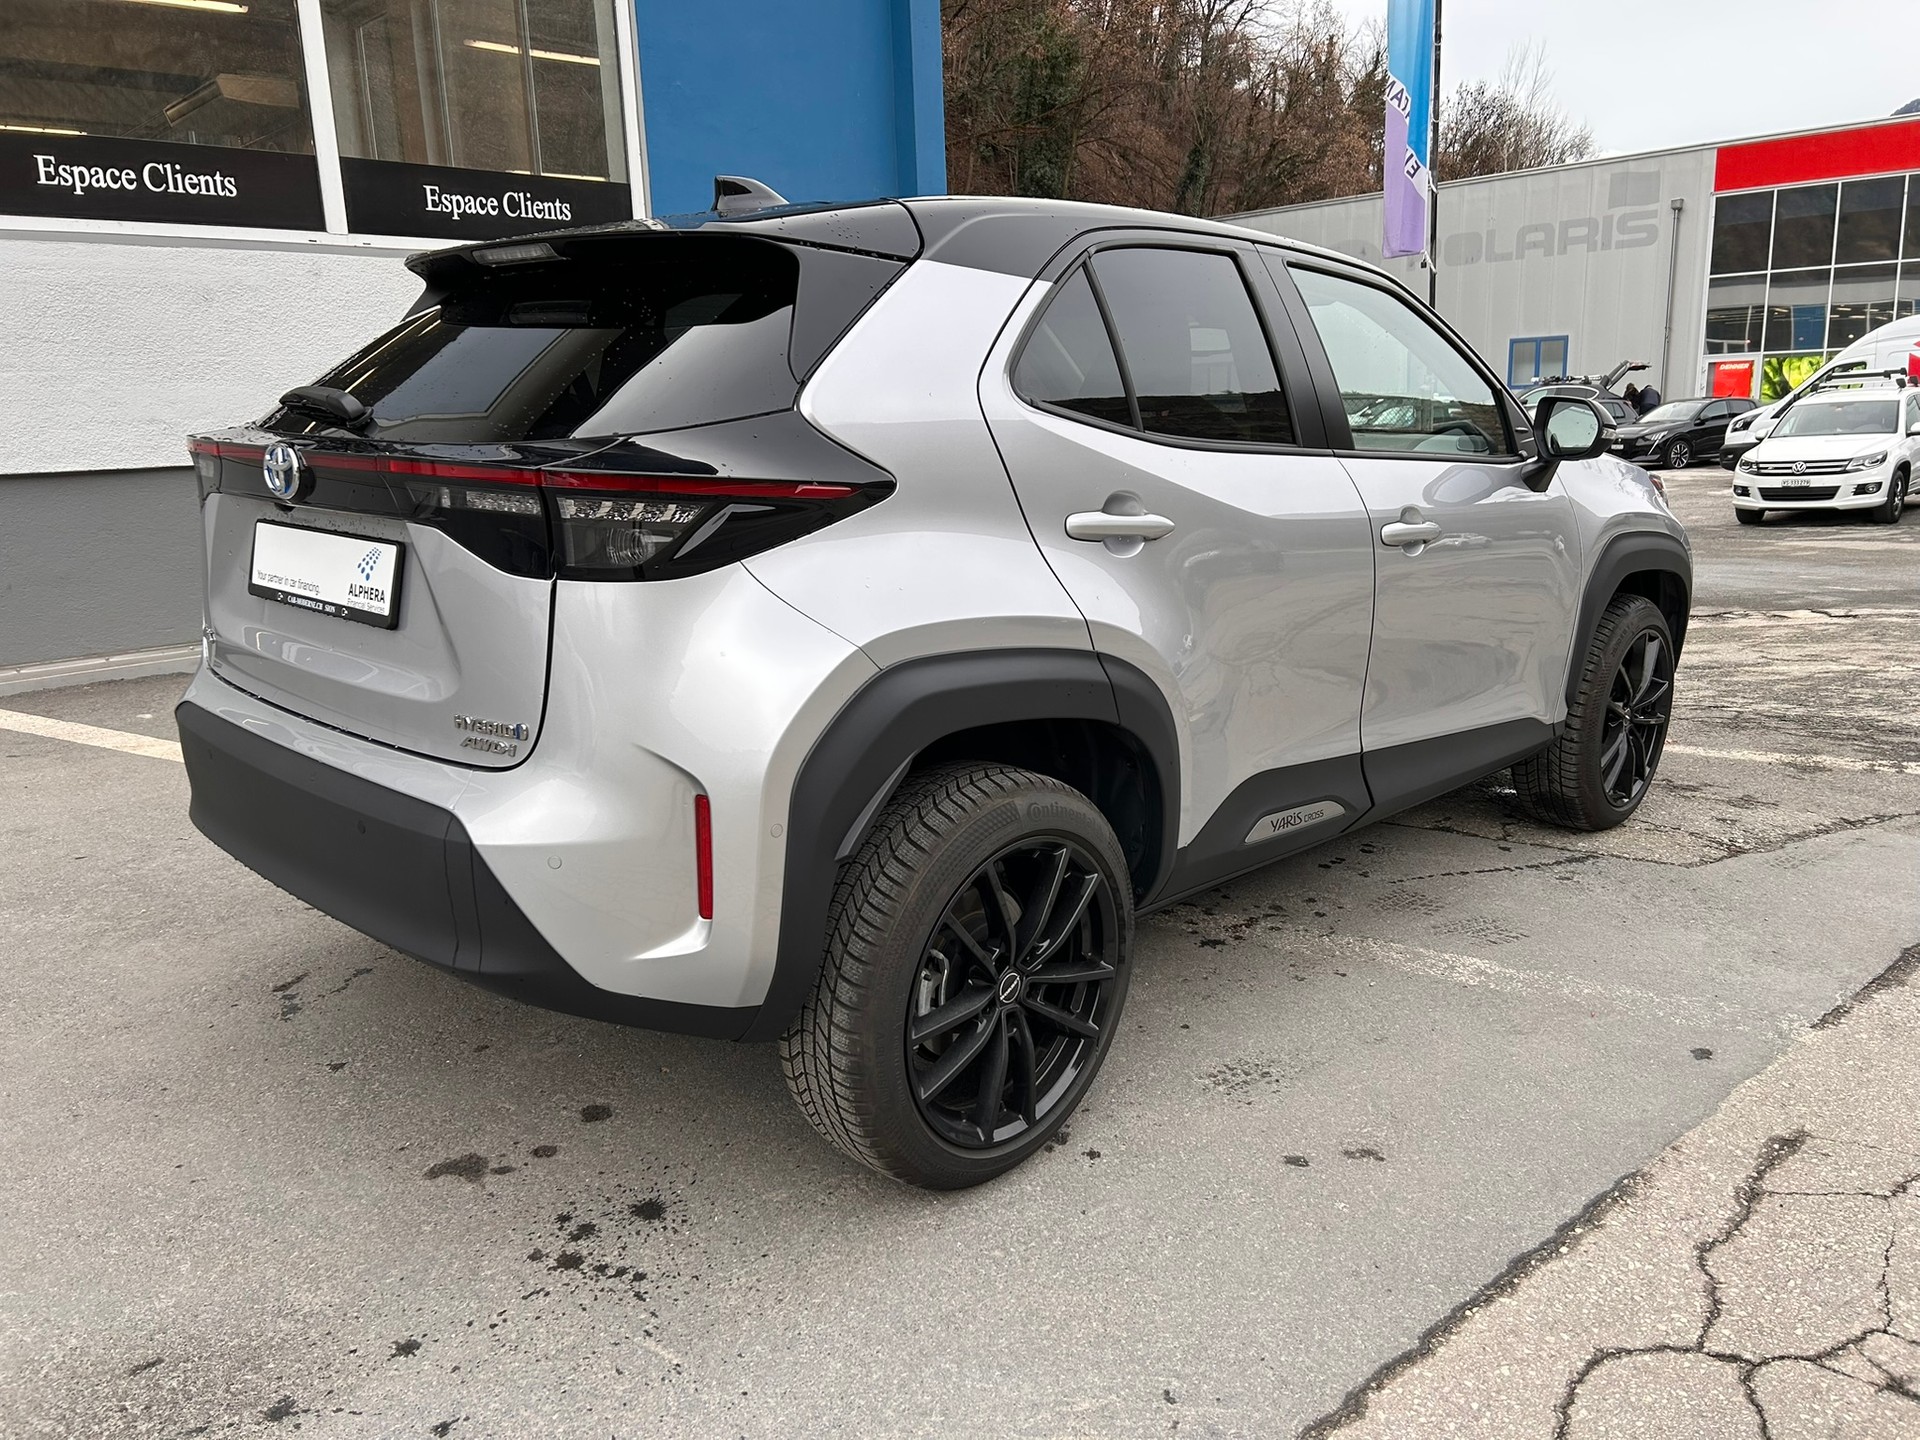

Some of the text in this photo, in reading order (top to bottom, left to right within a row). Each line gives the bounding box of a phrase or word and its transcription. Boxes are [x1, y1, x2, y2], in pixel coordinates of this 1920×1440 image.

[33, 154, 238, 198] Espace Clients
[422, 184, 572, 221] Espace Clients
[257, 569, 268, 581] Your
[267, 573, 283, 586] partner
[348, 583, 386, 604] ALPHERA
[346, 598, 386, 614] Financial Services
[454, 714, 517, 740] HYBRID
[1303, 808, 1325, 823] CROSS
